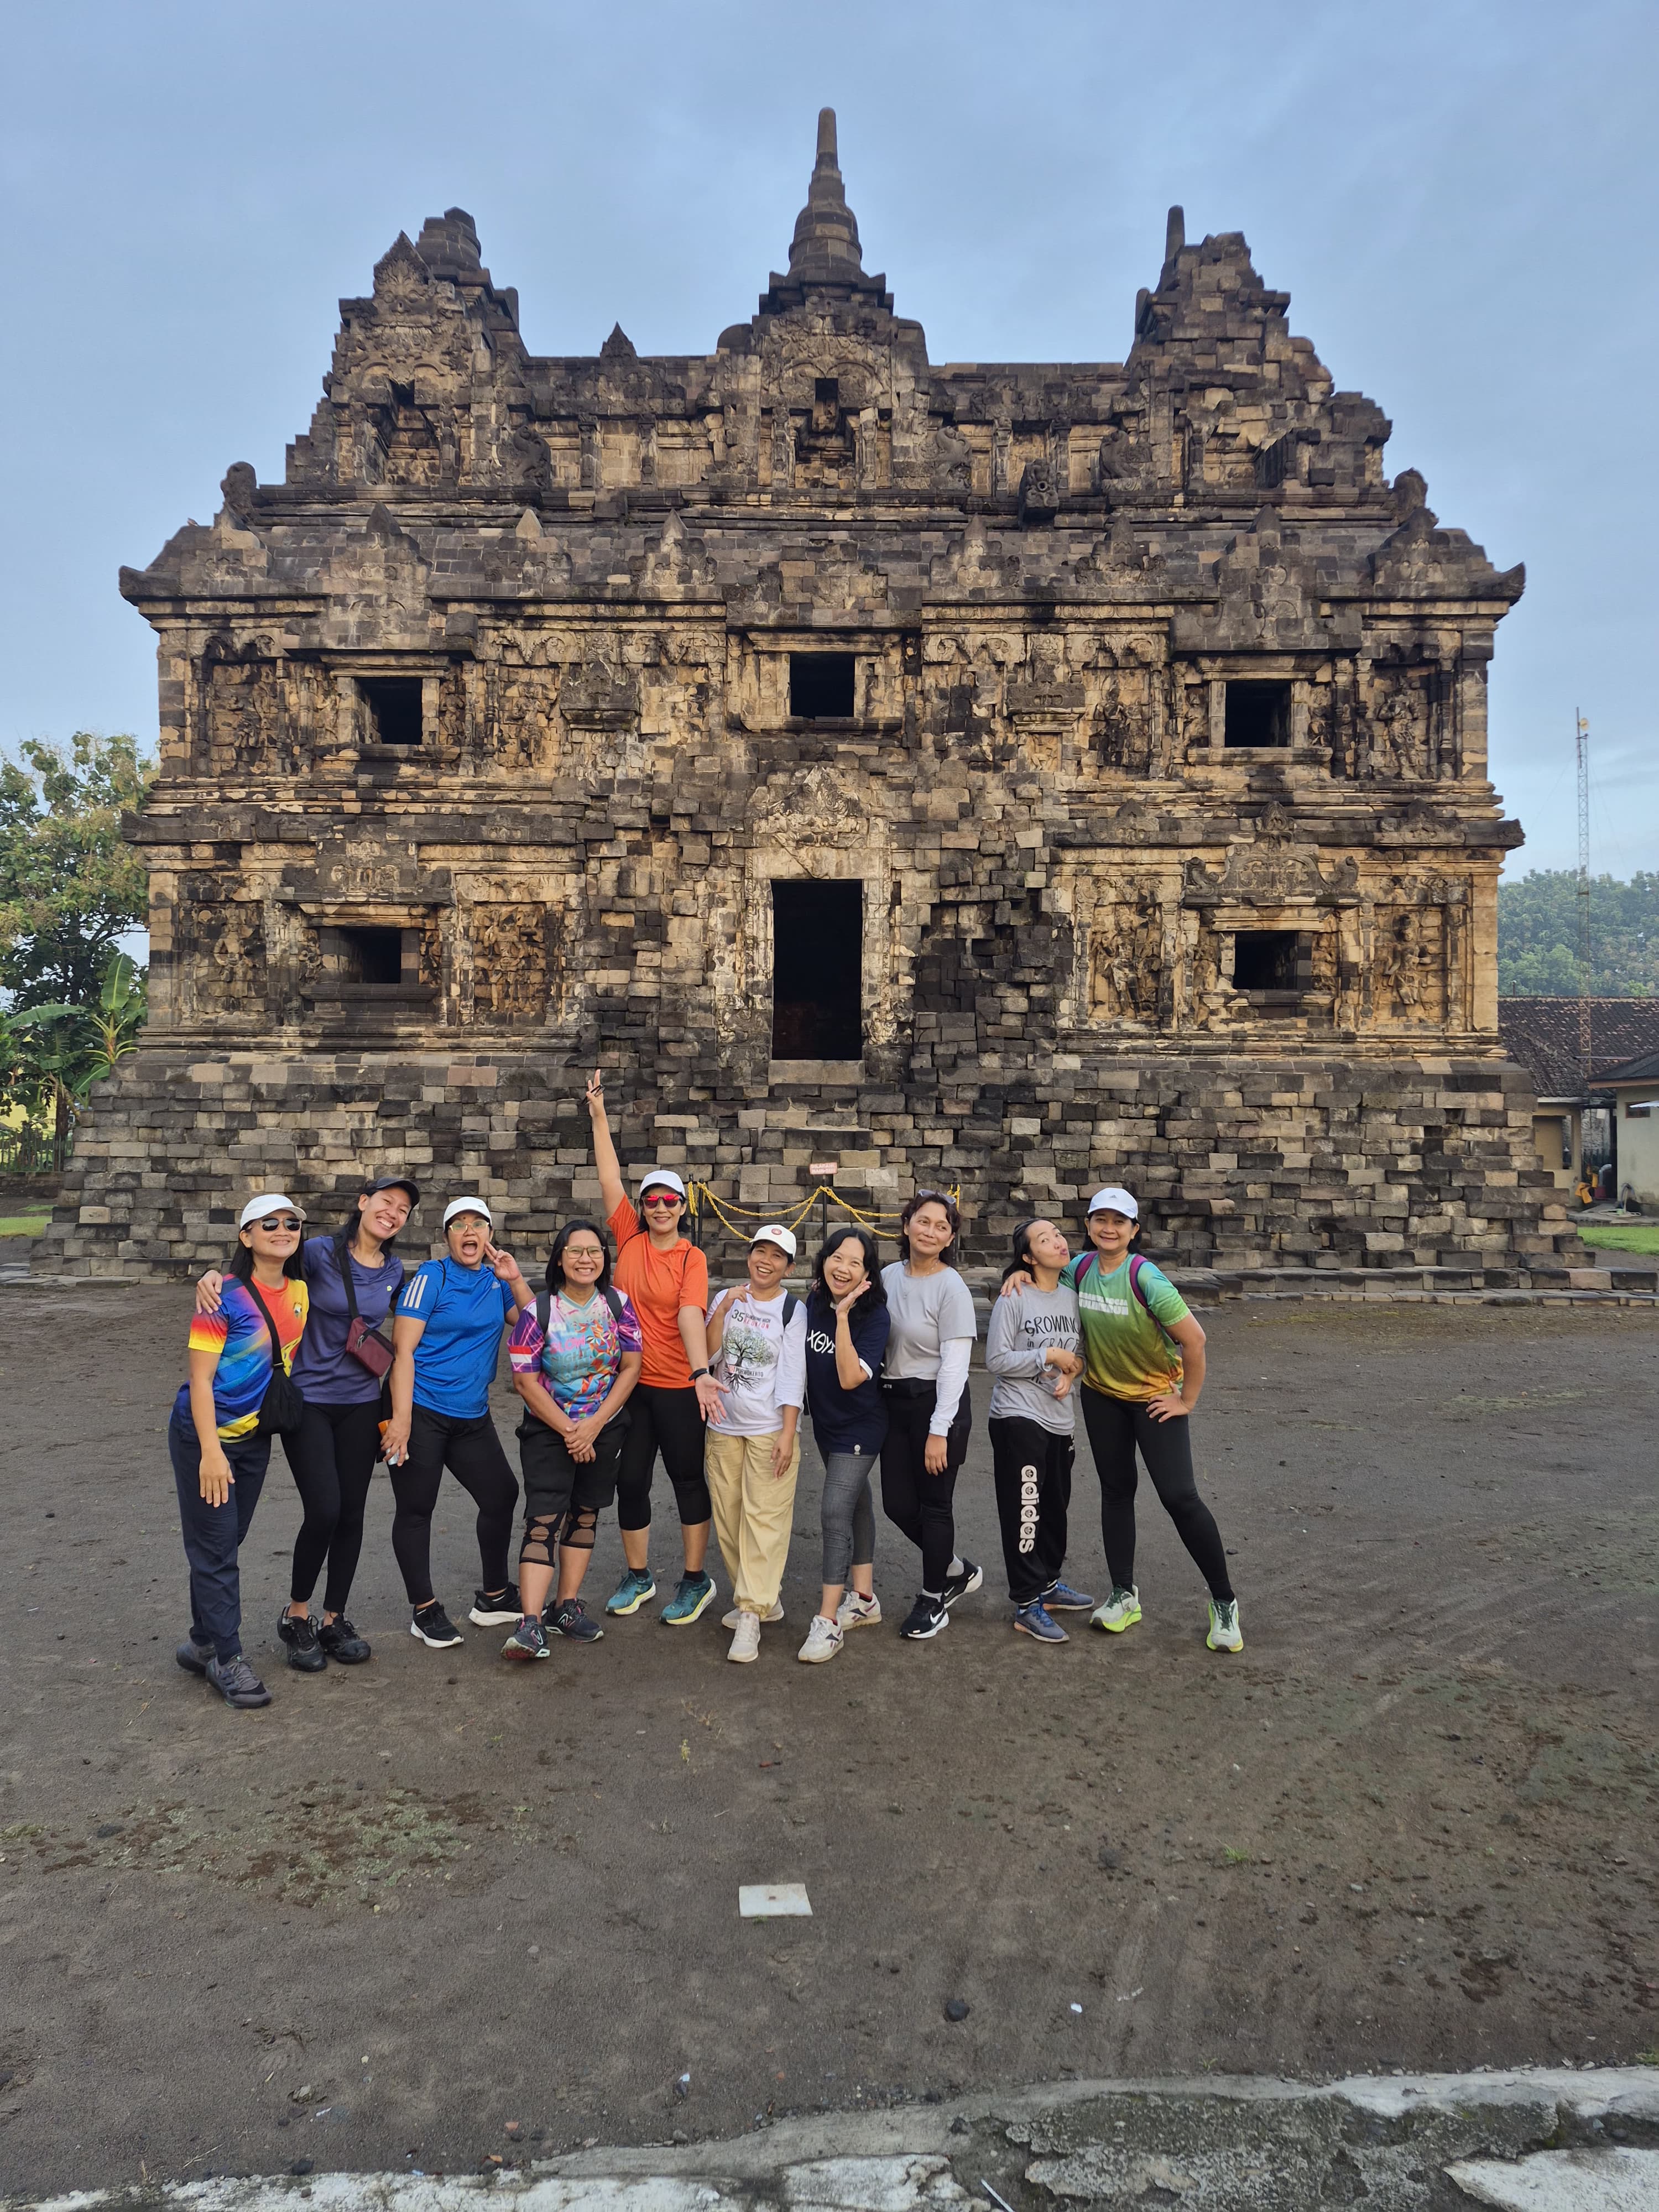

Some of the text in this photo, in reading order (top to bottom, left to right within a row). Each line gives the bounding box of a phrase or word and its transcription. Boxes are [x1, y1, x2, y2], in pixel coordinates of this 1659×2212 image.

[732, 1309, 745, 1322] 35
[1027, 1338, 1034, 1348] in
[1019, 1465, 1040, 1553] adidas
